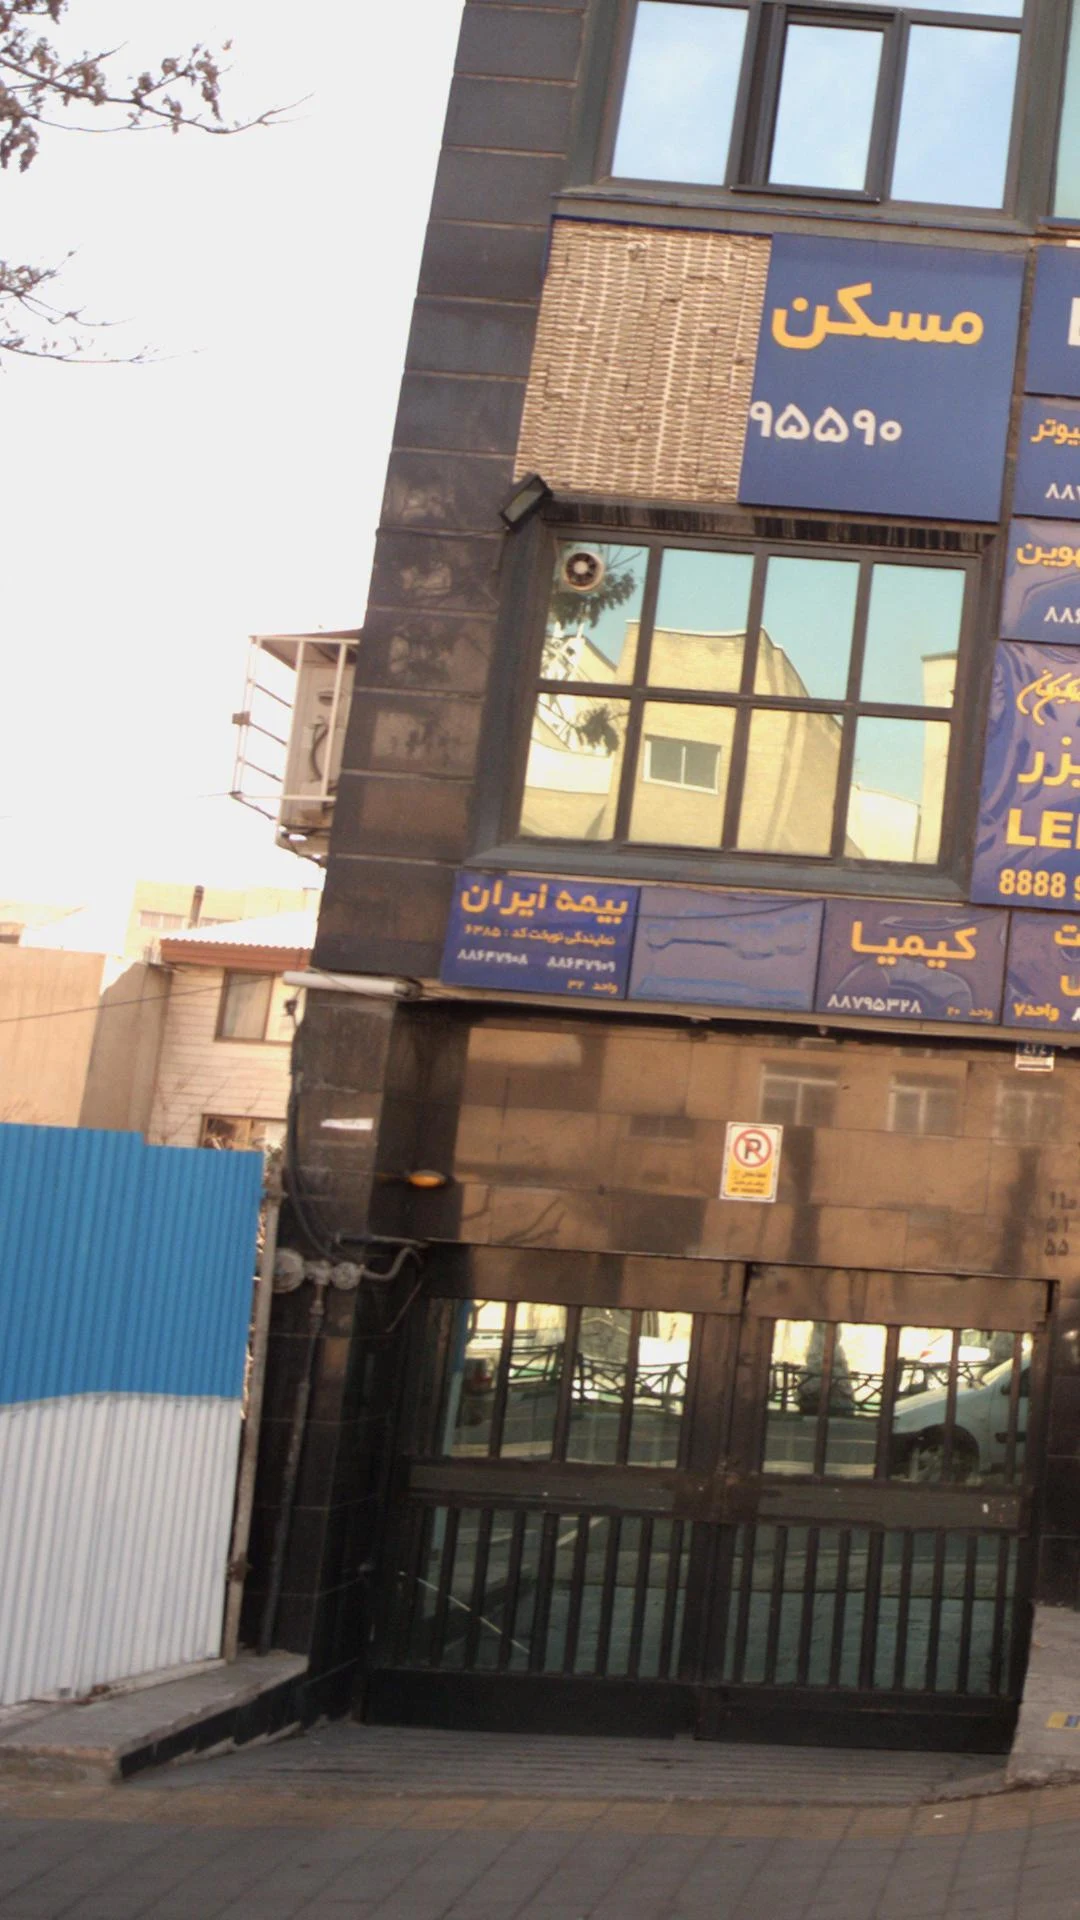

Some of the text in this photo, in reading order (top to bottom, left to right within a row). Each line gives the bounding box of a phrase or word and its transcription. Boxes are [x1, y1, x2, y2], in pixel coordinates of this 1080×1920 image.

[771, 281, 985, 350] مسکن
[1029, 417, 1080, 446] یوتر
[1006, 808, 1080, 850] LE
[460, 879, 629, 925] بیمه ایران
[999, 867, 1067, 898] 8888
[851, 920, 978, 969] کیمیا
